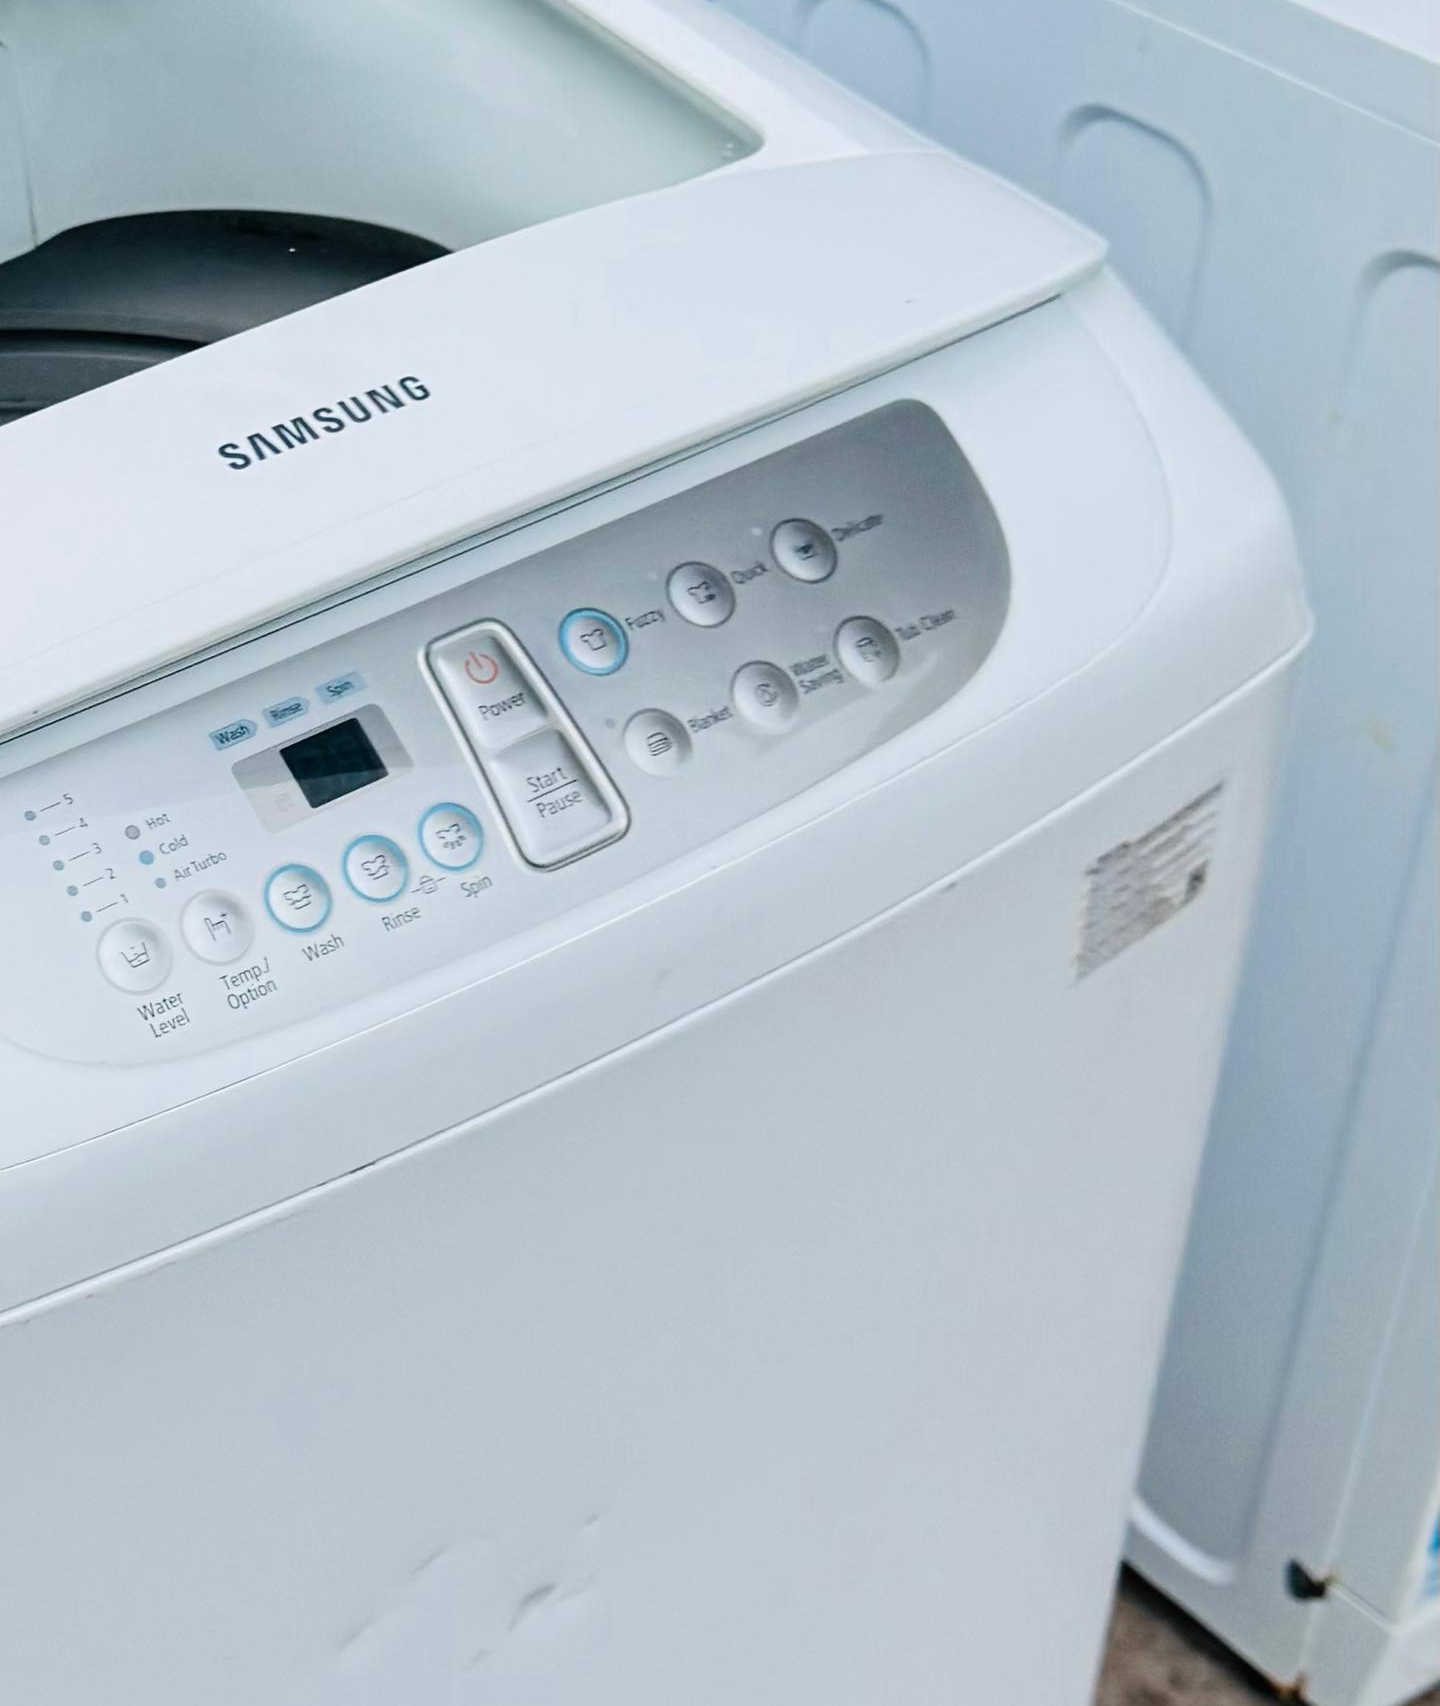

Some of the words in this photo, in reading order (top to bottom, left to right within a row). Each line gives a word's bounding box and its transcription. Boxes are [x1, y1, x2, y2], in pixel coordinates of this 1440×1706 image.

[218, 376, 431, 470] SAMSUNG
[625, 610, 665, 629] Fuzzy
[478, 691, 527, 721] Power
[214, 725, 250, 744] Wash
[526, 767, 568, 794] Start
[62, 794, 73, 805] 5
[536, 790, 582, 818] Pause
[146, 813, 172, 829] Hot
[92, 843, 102, 854] 3
[159, 835, 189, 855] Cold
[105, 868, 116, 879] 2
[191, 850, 227, 873] Turbo
[460, 874, 492, 899] Spin
[381, 906, 421, 932] Rinse
[302, 935, 344, 963] Wash
[227, 978, 278, 1010] Option
[137, 993, 184, 1022] Water
[150, 1009, 190, 1038] Level
